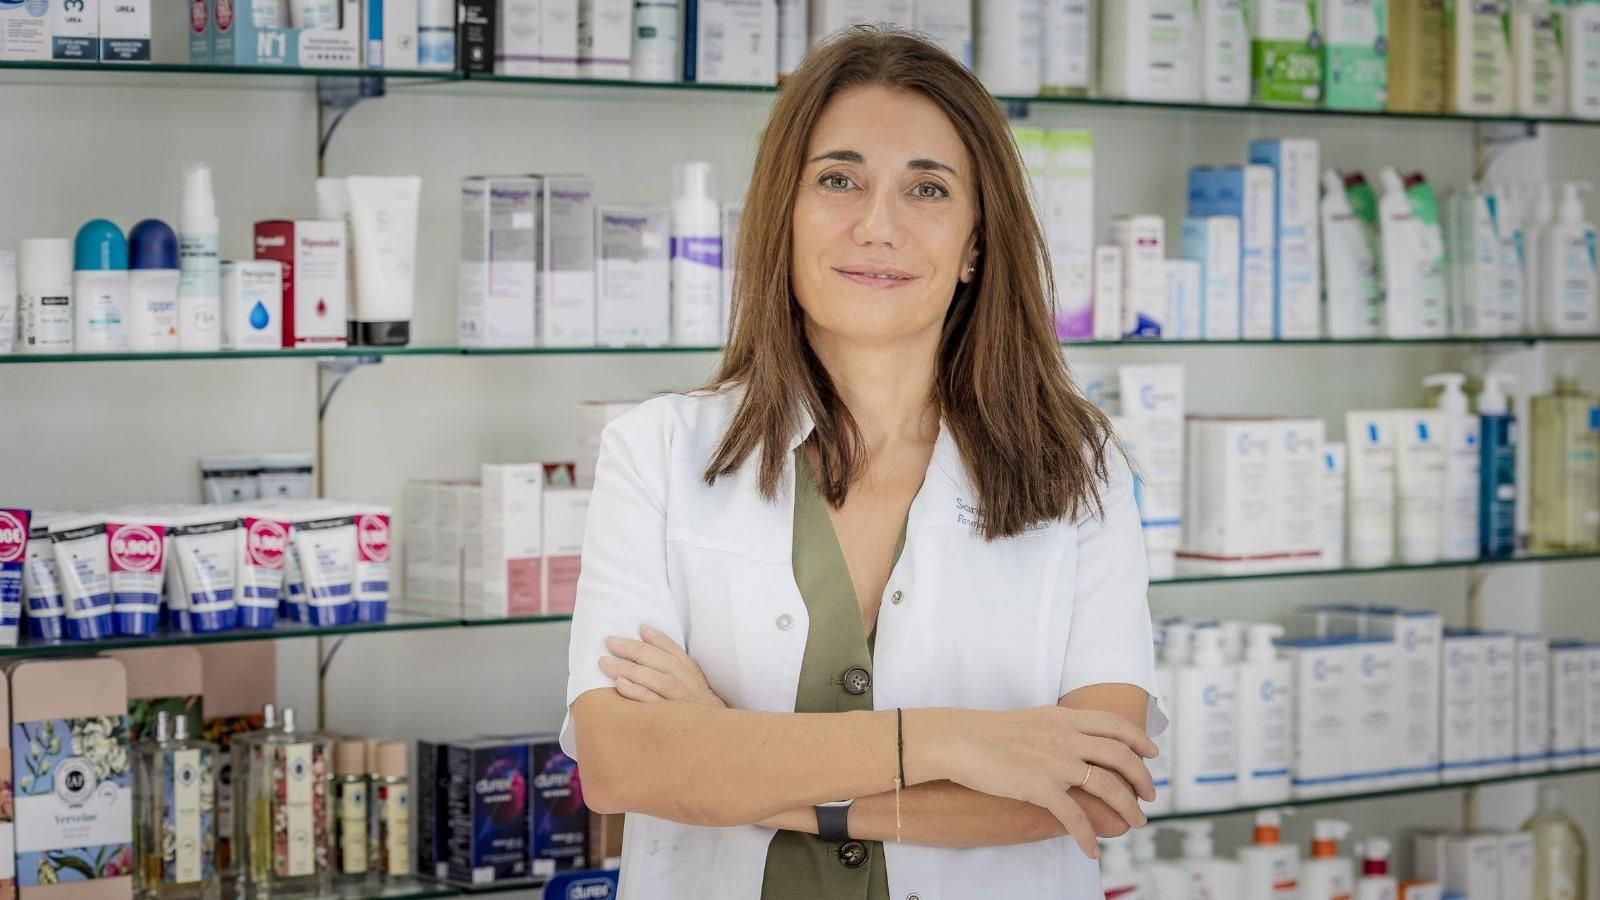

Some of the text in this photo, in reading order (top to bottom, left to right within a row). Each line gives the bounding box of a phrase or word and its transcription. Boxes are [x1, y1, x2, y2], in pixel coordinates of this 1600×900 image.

[115, 5, 135, 13] UREA
[475, 777, 512, 794] durex
[534, 772, 571, 789] durex
[570, 883, 609, 899] durex
